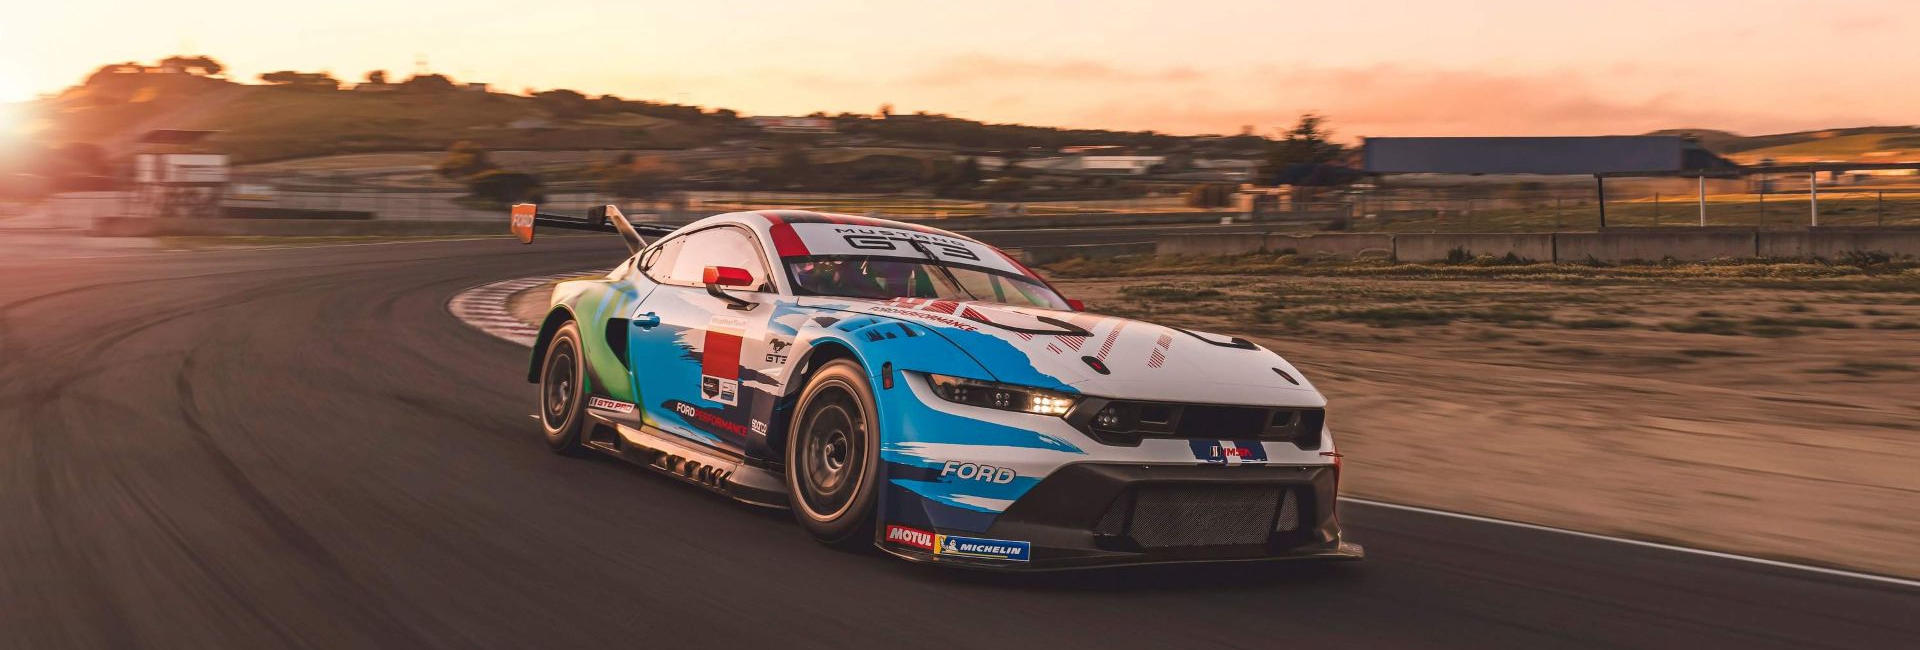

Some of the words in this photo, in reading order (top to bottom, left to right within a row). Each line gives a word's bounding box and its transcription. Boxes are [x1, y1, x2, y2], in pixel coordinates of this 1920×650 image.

[512, 213, 534, 228] FORD
[834, 228, 965, 247] MUSTANG
[842, 234, 981, 262] GT3
[940, 459, 1016, 484] FORD
[889, 527, 932, 547] MOTUL
[960, 543, 1022, 555] MICHELIN
